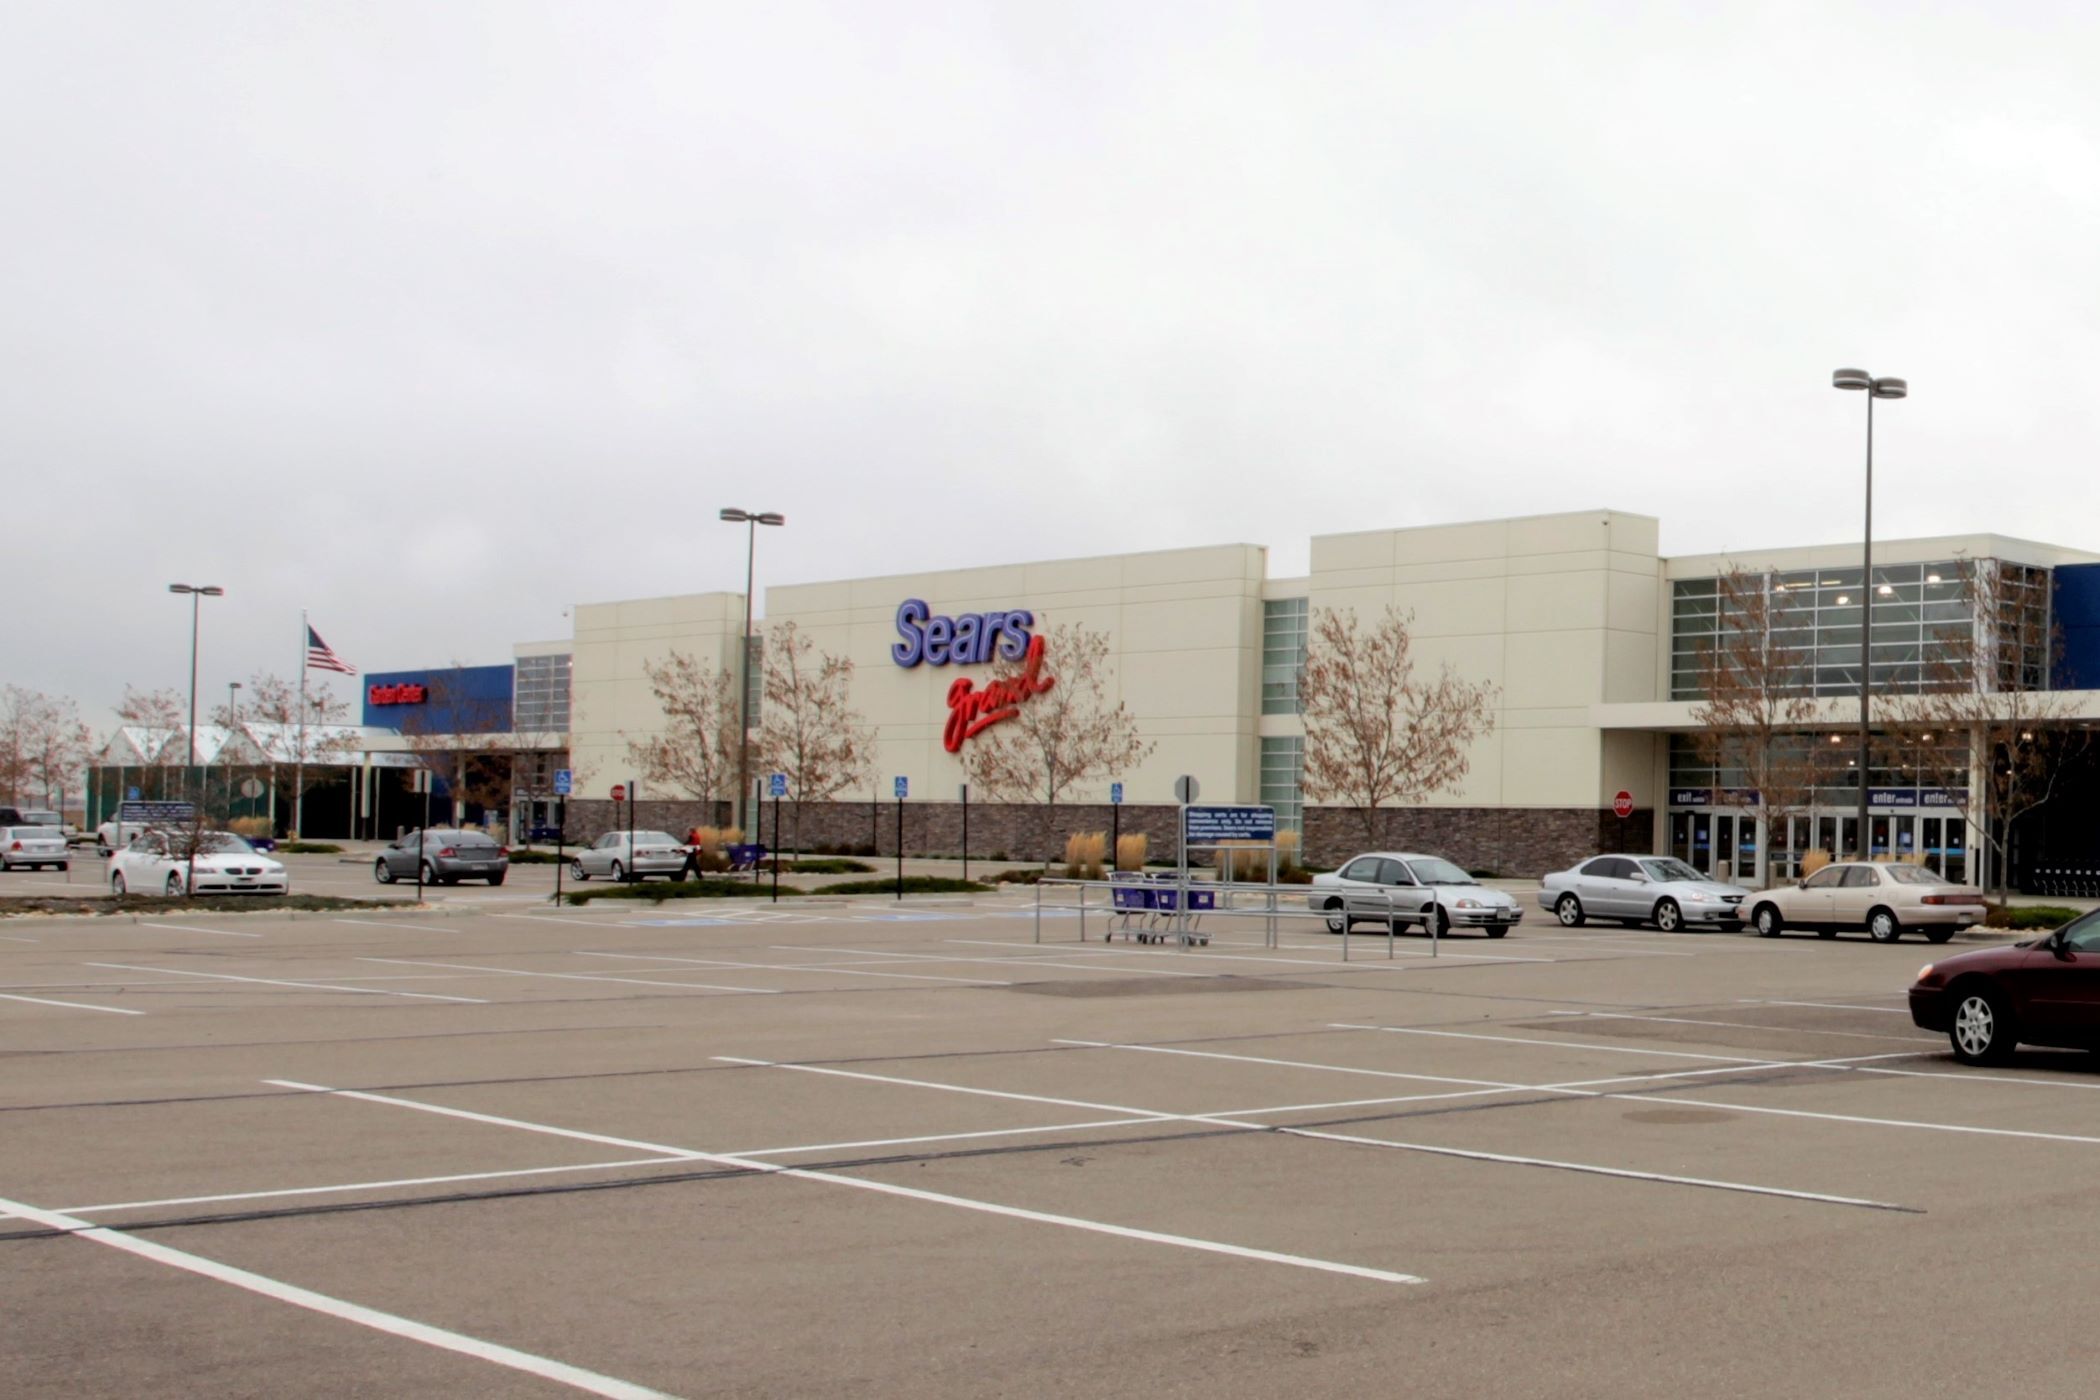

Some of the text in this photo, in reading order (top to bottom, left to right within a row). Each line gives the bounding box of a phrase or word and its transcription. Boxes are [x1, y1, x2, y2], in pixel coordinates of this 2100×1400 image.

[892, 598, 1034, 668] Sears
[1615, 798, 1631, 809] STOP
[1677, 792, 1692, 803] exit
[1872, 792, 1896, 804] enter
[1924, 792, 1948, 804] enter
